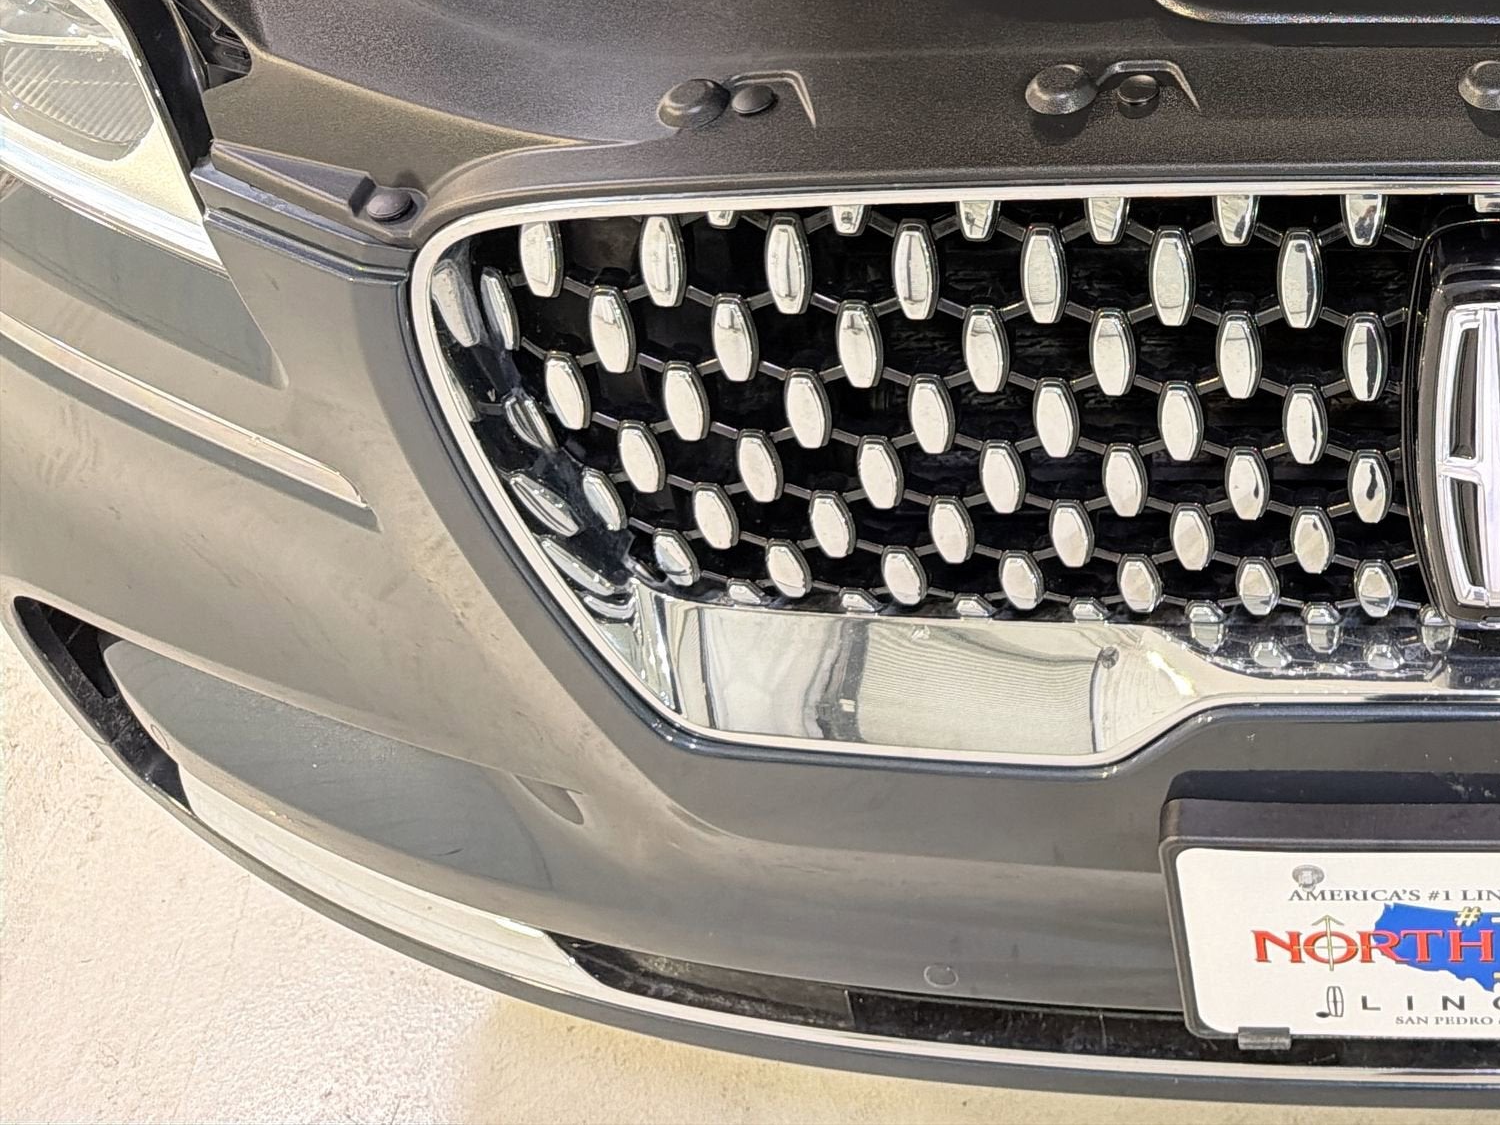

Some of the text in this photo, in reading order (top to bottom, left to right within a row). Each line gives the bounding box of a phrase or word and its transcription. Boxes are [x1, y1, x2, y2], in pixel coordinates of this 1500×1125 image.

[1288, 889, 1421, 902] AMERICA'S
[1427, 889, 1452, 901] #1
[1251, 929, 1495, 965] NORTH
[1395, 1016, 1429, 1025] SAN
[1434, 1016, 1493, 1026] PEDRO
